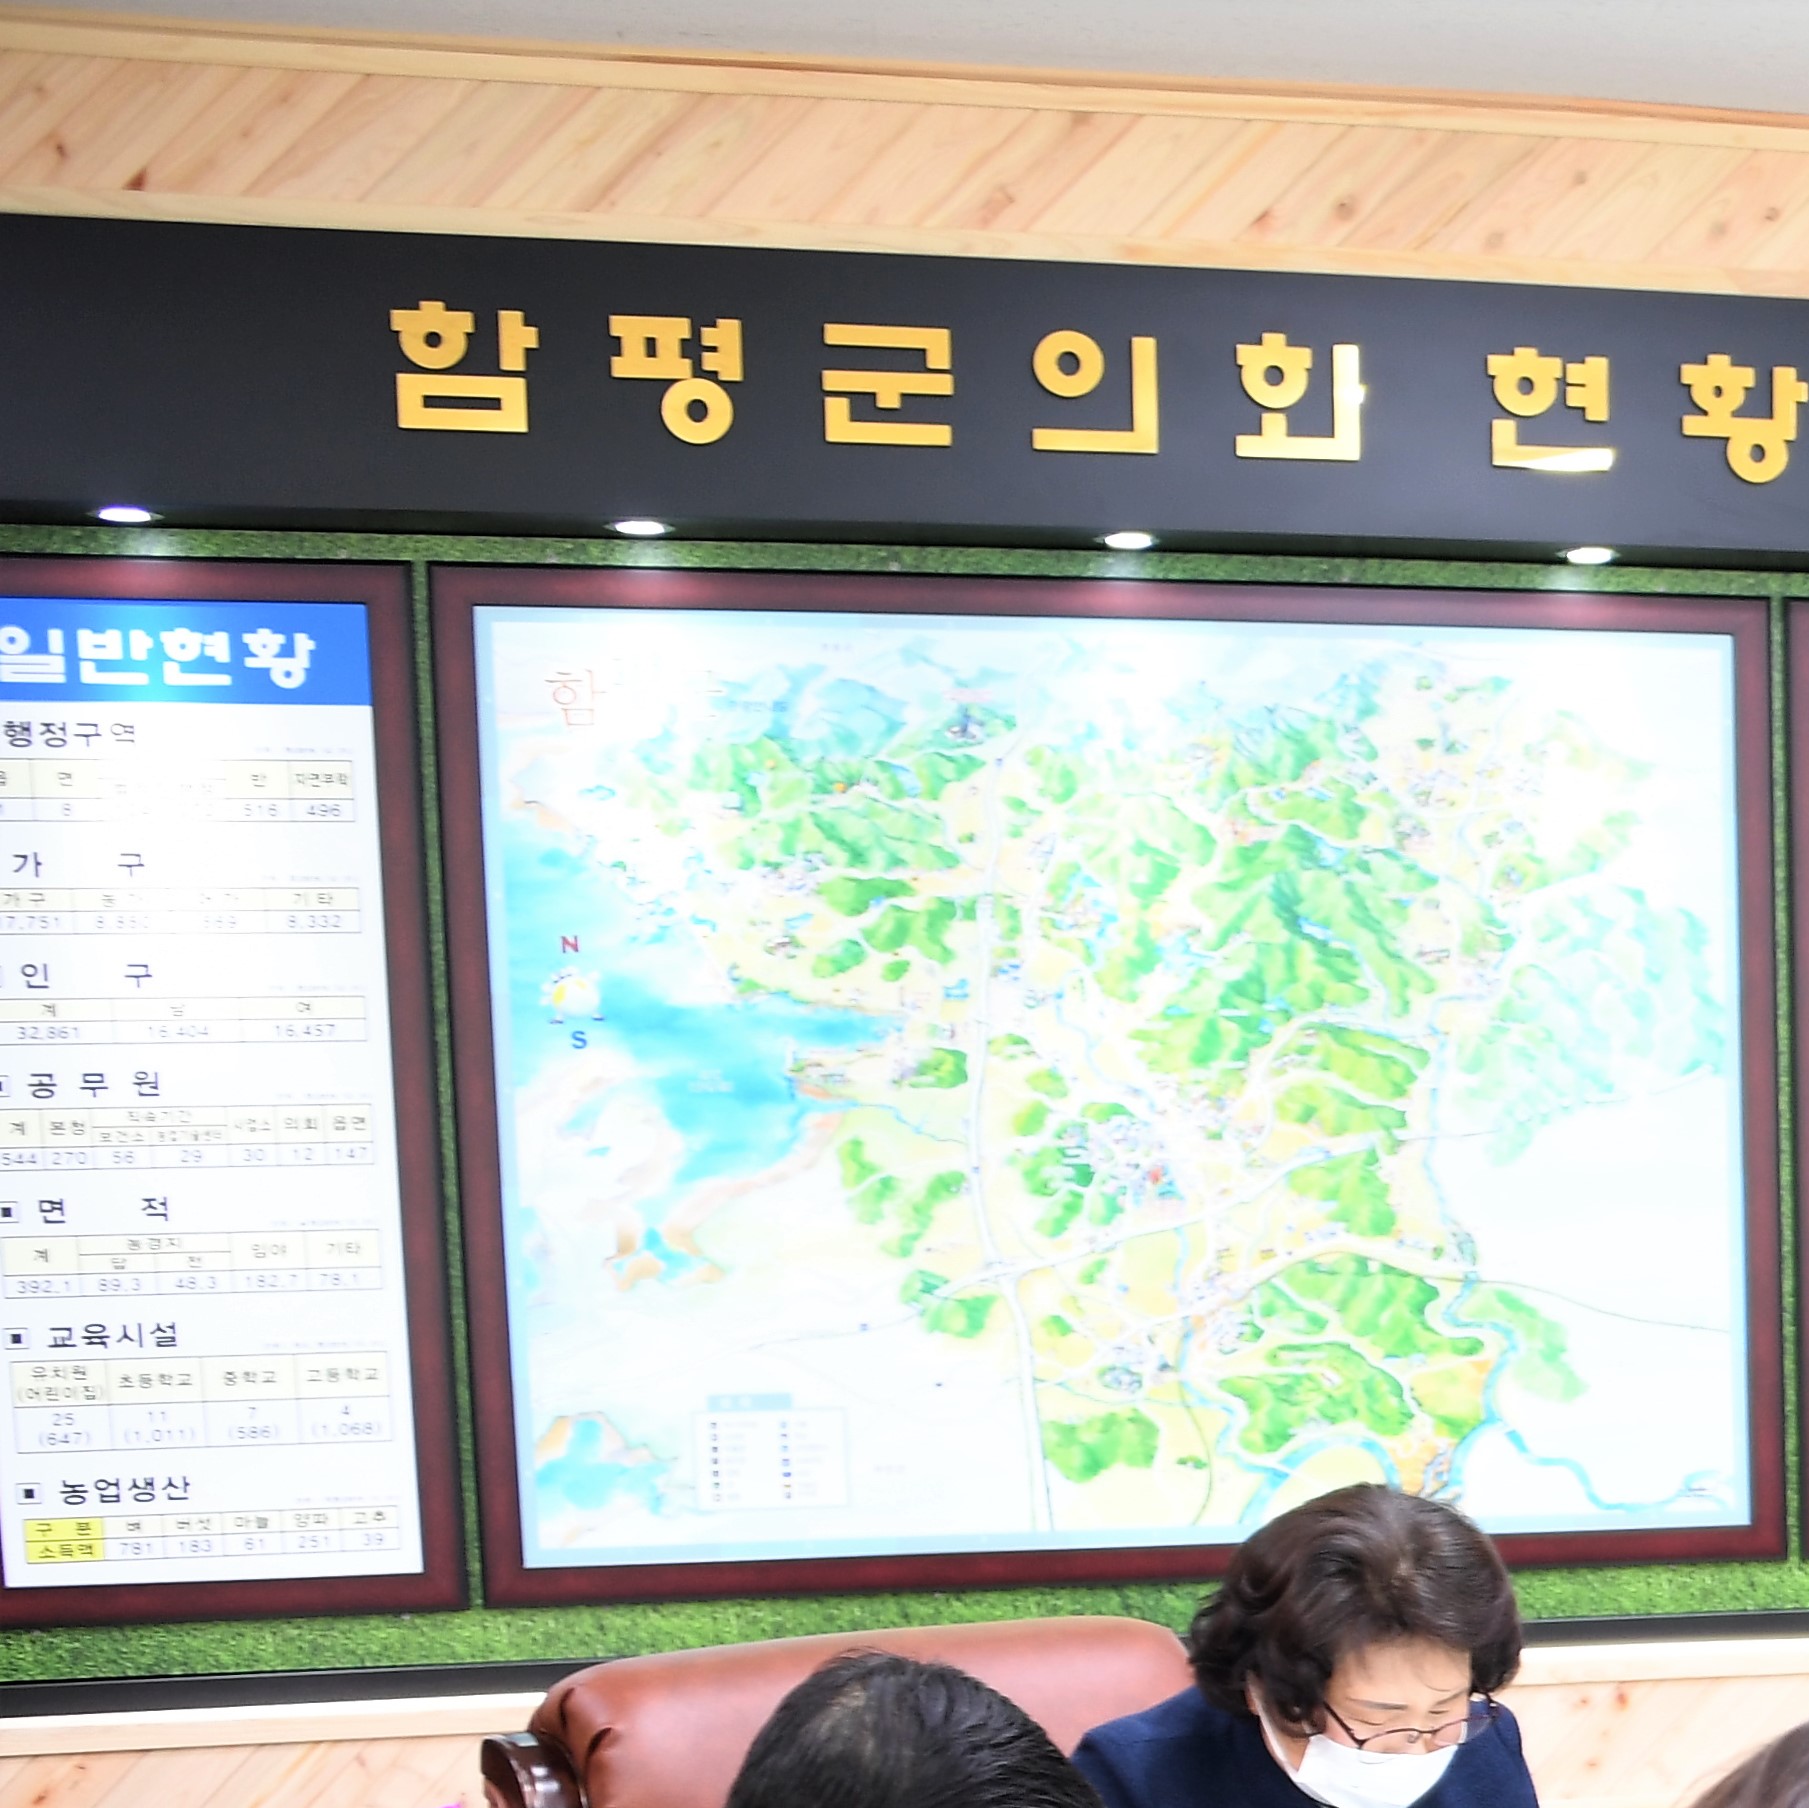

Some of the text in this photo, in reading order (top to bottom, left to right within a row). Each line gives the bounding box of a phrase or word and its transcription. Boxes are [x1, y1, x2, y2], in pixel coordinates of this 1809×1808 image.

[390, 299, 1366, 463] 함평군의회
[0, 626, 316, 689] 일반현황
[3, 721, 134, 748] 행정구역
[561, 936, 579, 953] N
[571, 1030, 588, 1049] S
[52, 1152, 88, 1167] 270
[48, 1323, 177, 1348] 교육시설
[118, 1374, 192, 1389] 초등학교
[223, 1371, 277, 1386] 중학교
[306, 1368, 379, 1383] 고등학교
[59, 1476, 190, 1505] 농업생산
